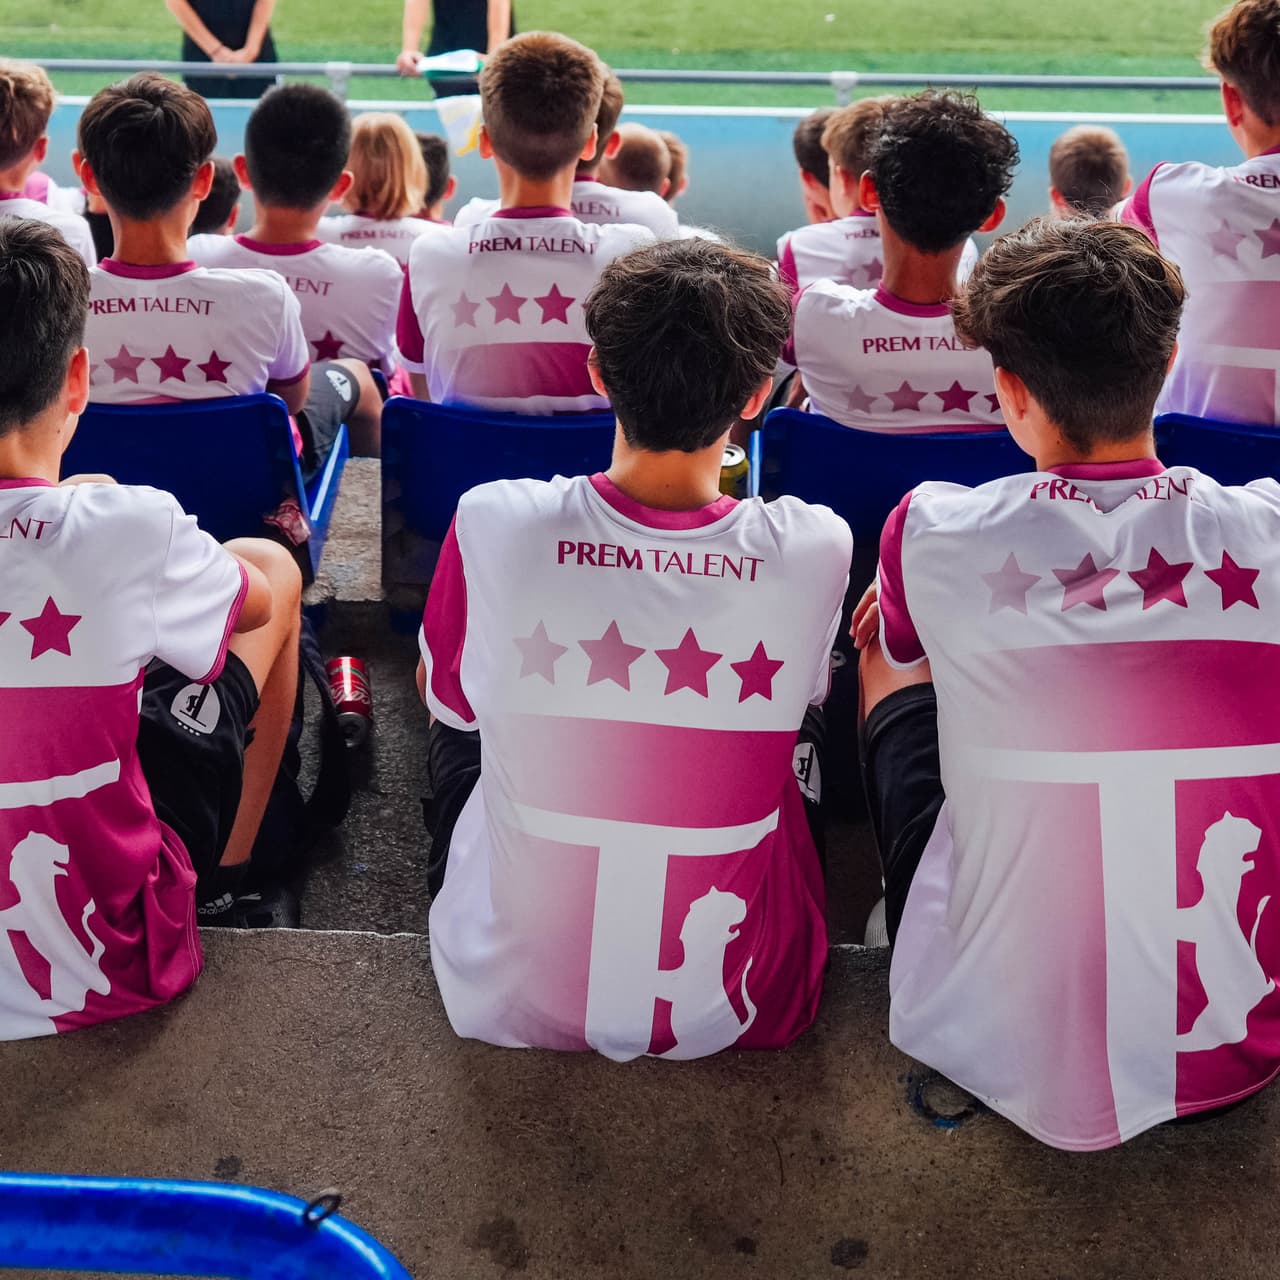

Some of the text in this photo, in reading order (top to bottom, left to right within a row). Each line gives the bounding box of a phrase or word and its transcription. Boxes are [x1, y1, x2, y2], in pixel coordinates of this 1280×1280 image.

[571, 201, 621, 217] ALENT
[468, 235, 598, 255] PREM TALENT
[286, 275, 334, 297] LENT
[139, 296, 216, 316] TALENT
[862, 336, 972, 354] PREM TAL
[557, 540, 765, 582] PREM TALENT
